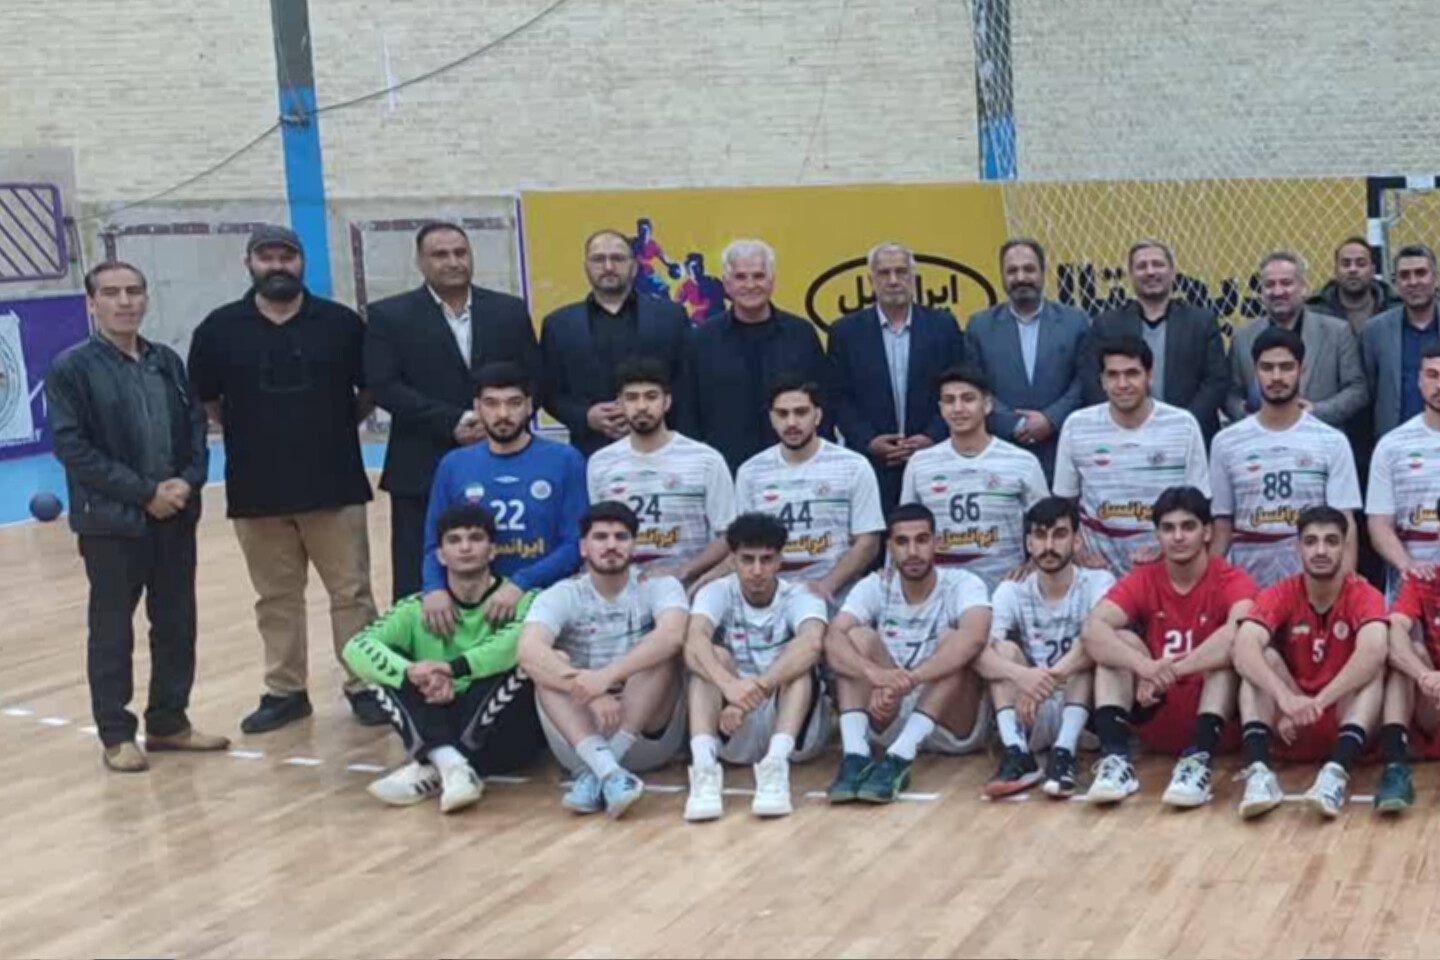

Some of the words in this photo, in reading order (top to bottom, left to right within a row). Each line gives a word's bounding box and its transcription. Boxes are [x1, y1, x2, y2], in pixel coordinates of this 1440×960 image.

[838, 274, 958, 314] ایرال
[1263, 470, 1292, 500] 88
[490, 499, 525, 530] 22
[629, 494, 661, 523] 24
[780, 500, 812, 531] 44
[950, 493, 980, 523] 66
[906, 641, 922, 669] 7
[1162, 629, 1192, 658] 21
[1312, 639, 1325, 662] 5
